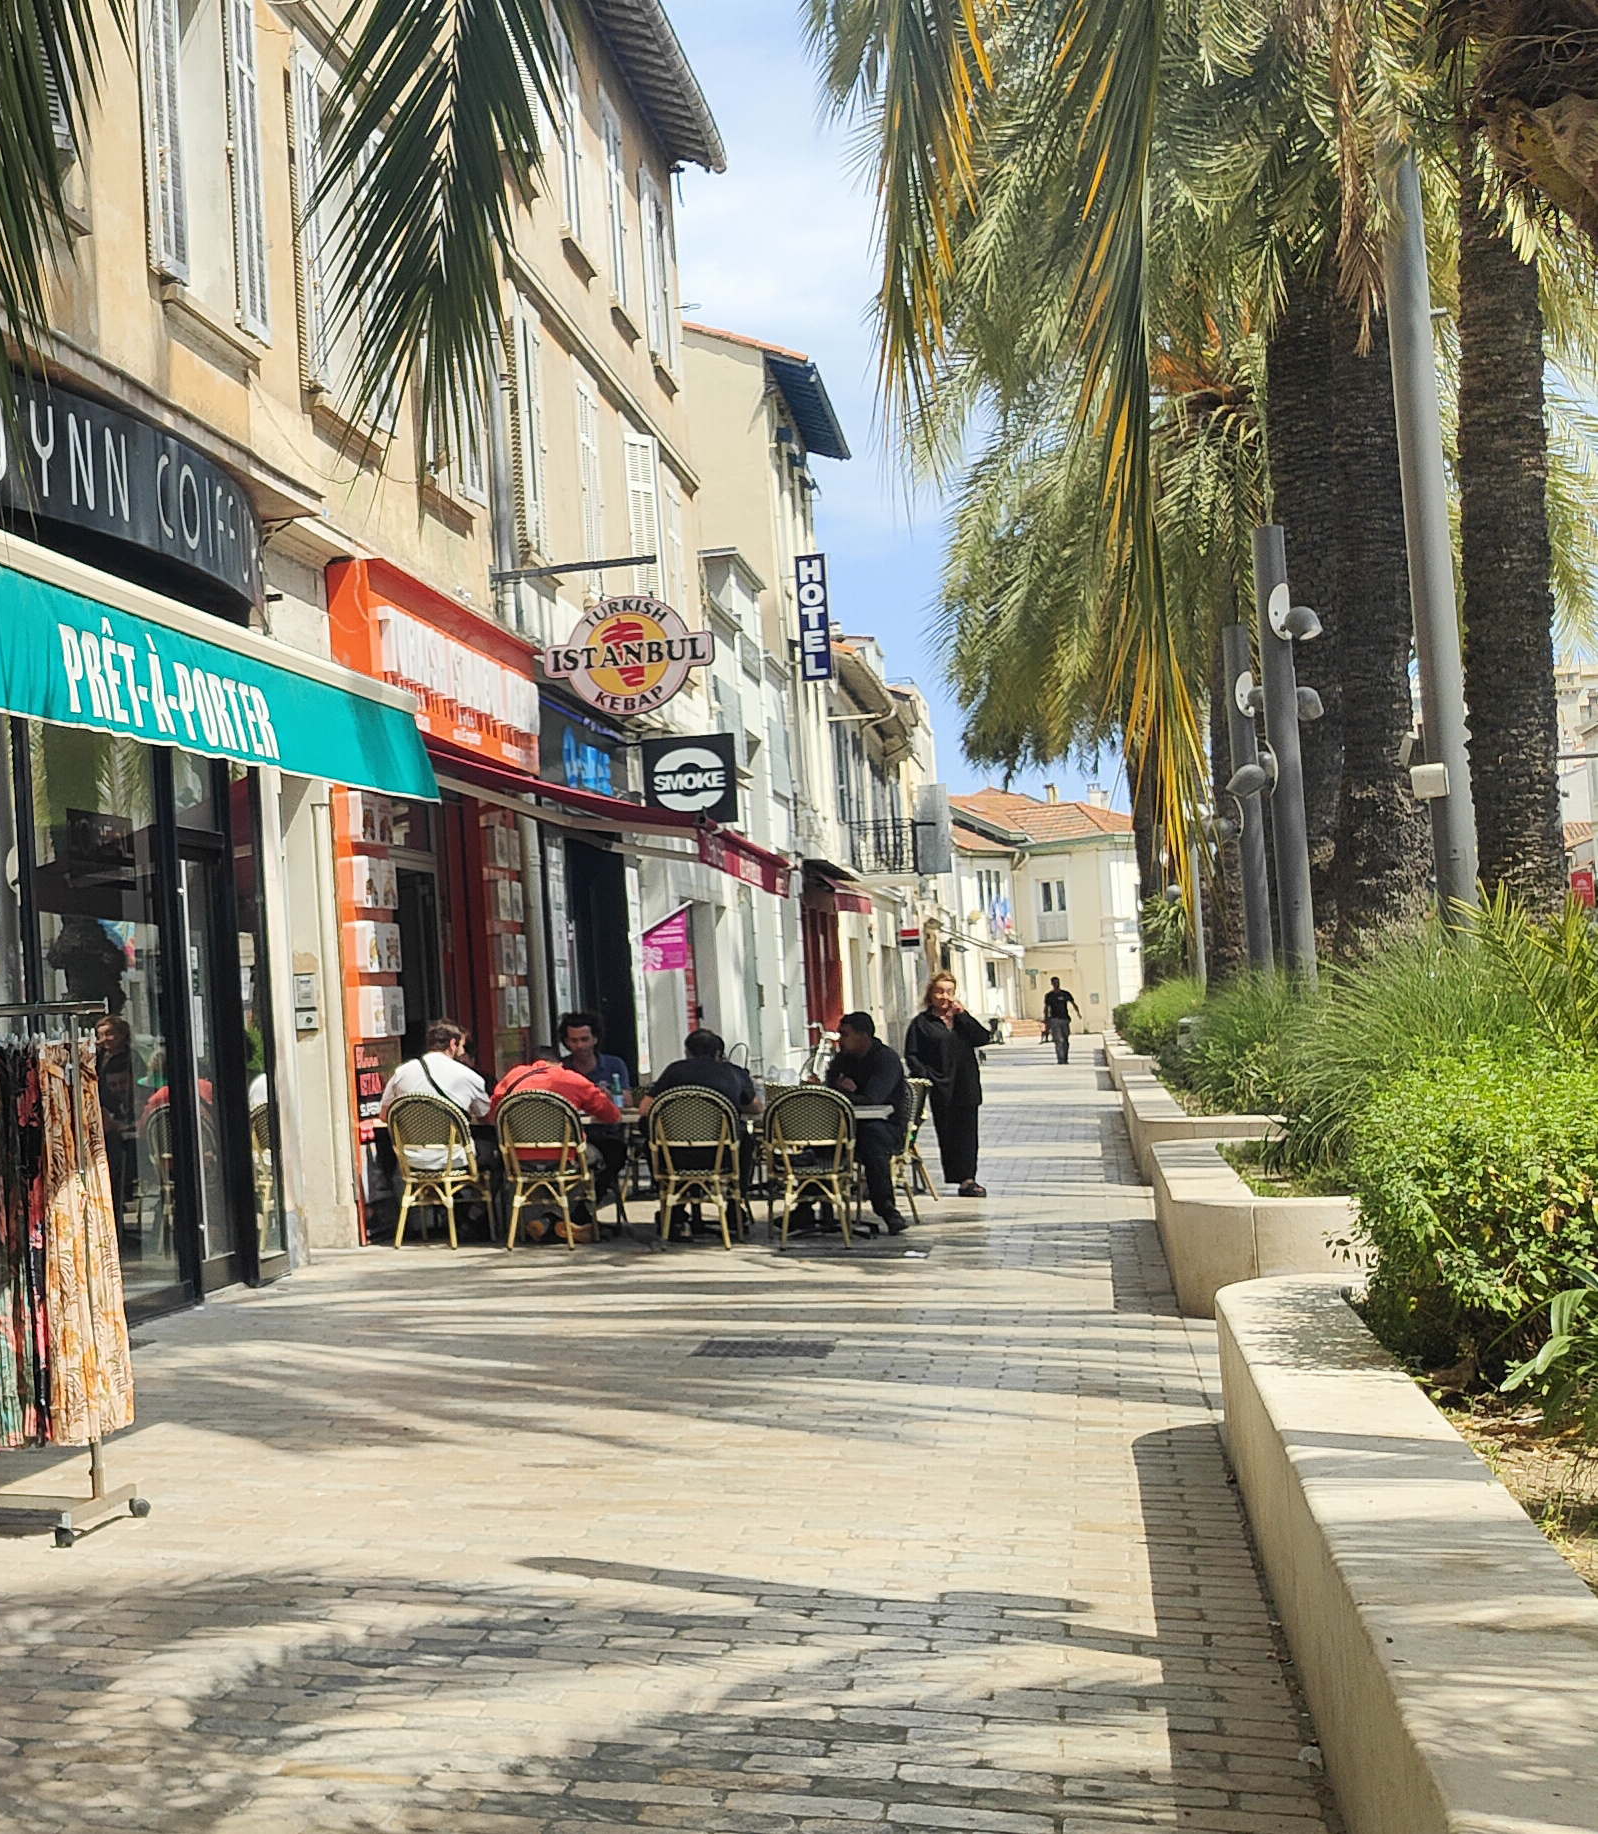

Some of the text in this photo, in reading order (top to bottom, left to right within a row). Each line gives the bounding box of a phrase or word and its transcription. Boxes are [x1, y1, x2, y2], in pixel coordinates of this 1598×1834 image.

[583, 598, 669, 628] TURKISH
[798, 558, 828, 677] HOTEL
[551, 636, 706, 673] ISTANBUL
[58, 617, 280, 760] PRÊT-À-PORTER
[593, 684, 663, 711] KEBAP
[653, 770, 727, 791] SMOKE
